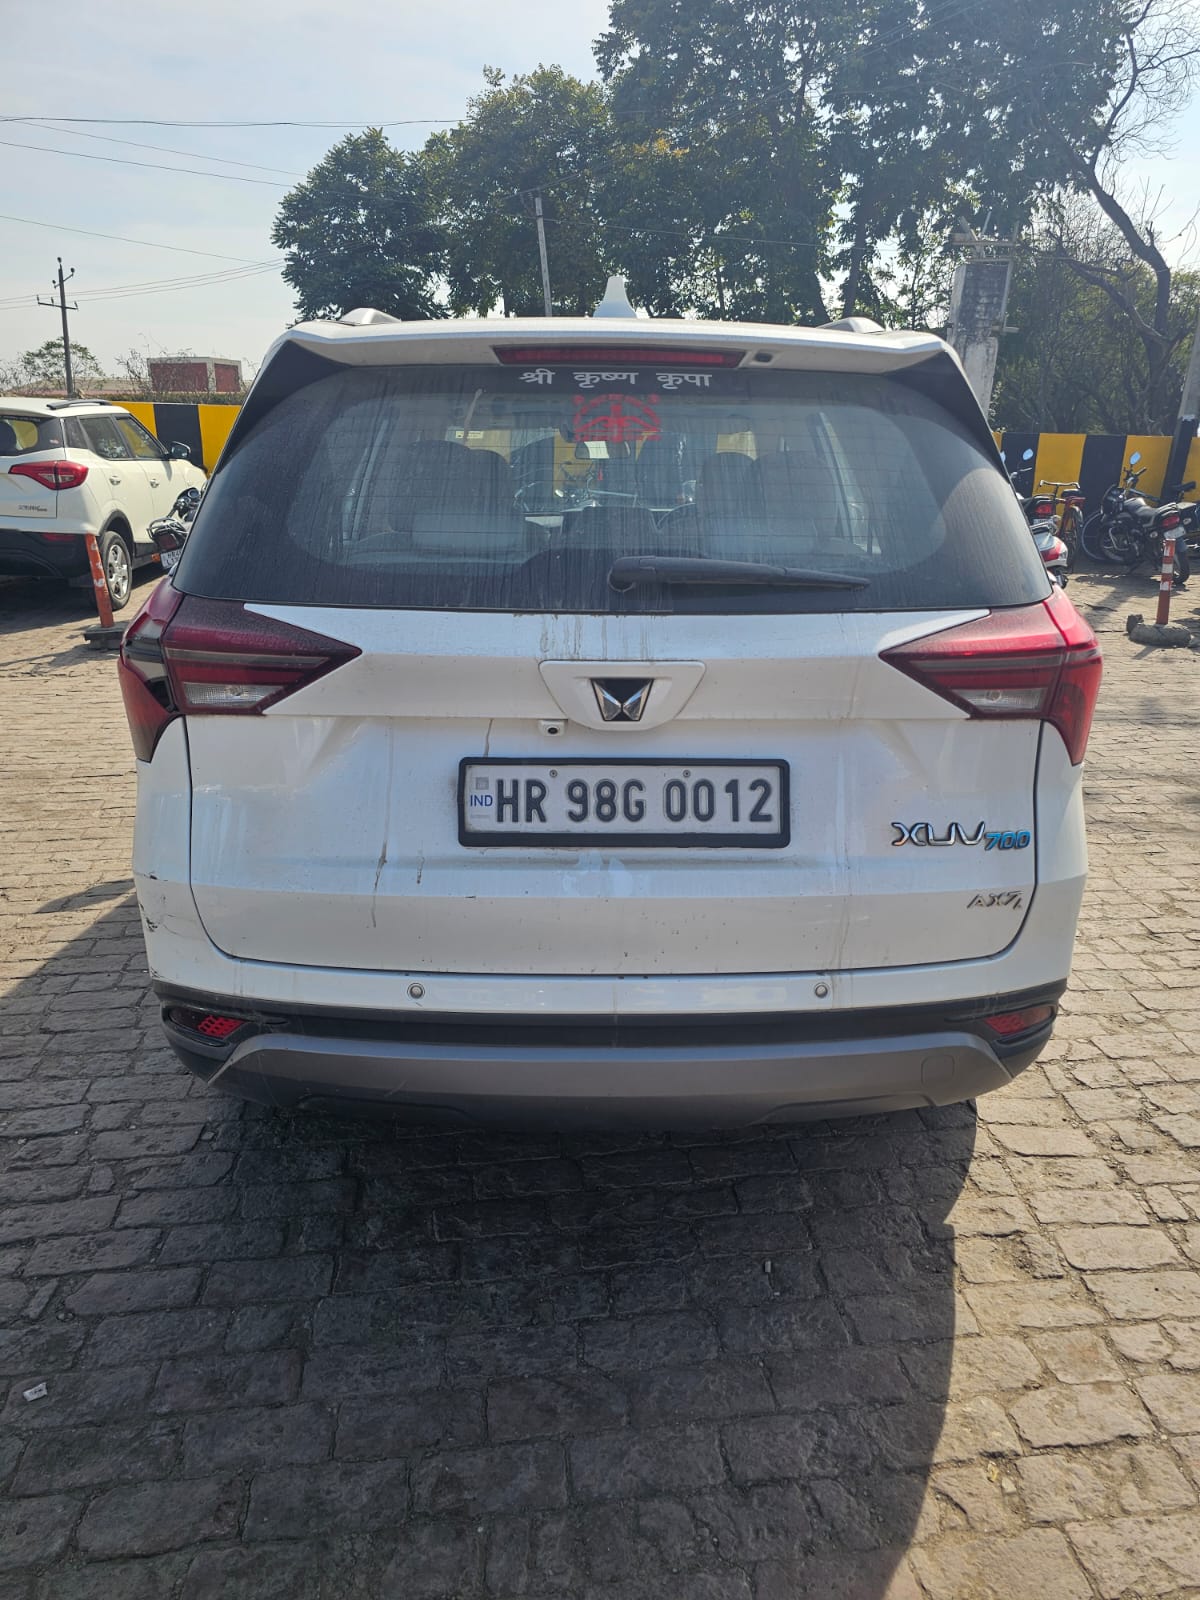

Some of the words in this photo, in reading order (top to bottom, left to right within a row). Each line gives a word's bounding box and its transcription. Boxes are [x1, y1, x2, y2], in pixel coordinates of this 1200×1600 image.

[519, 368, 556, 385] श्री
[572, 371, 640, 389] कृष्ण
[656, 372, 713, 390] कृपा
[470, 794, 493, 807] IND
[496, 779, 547, 823] HR
[567, 779, 645, 823] 98G
[665, 778, 773, 823] 0012
